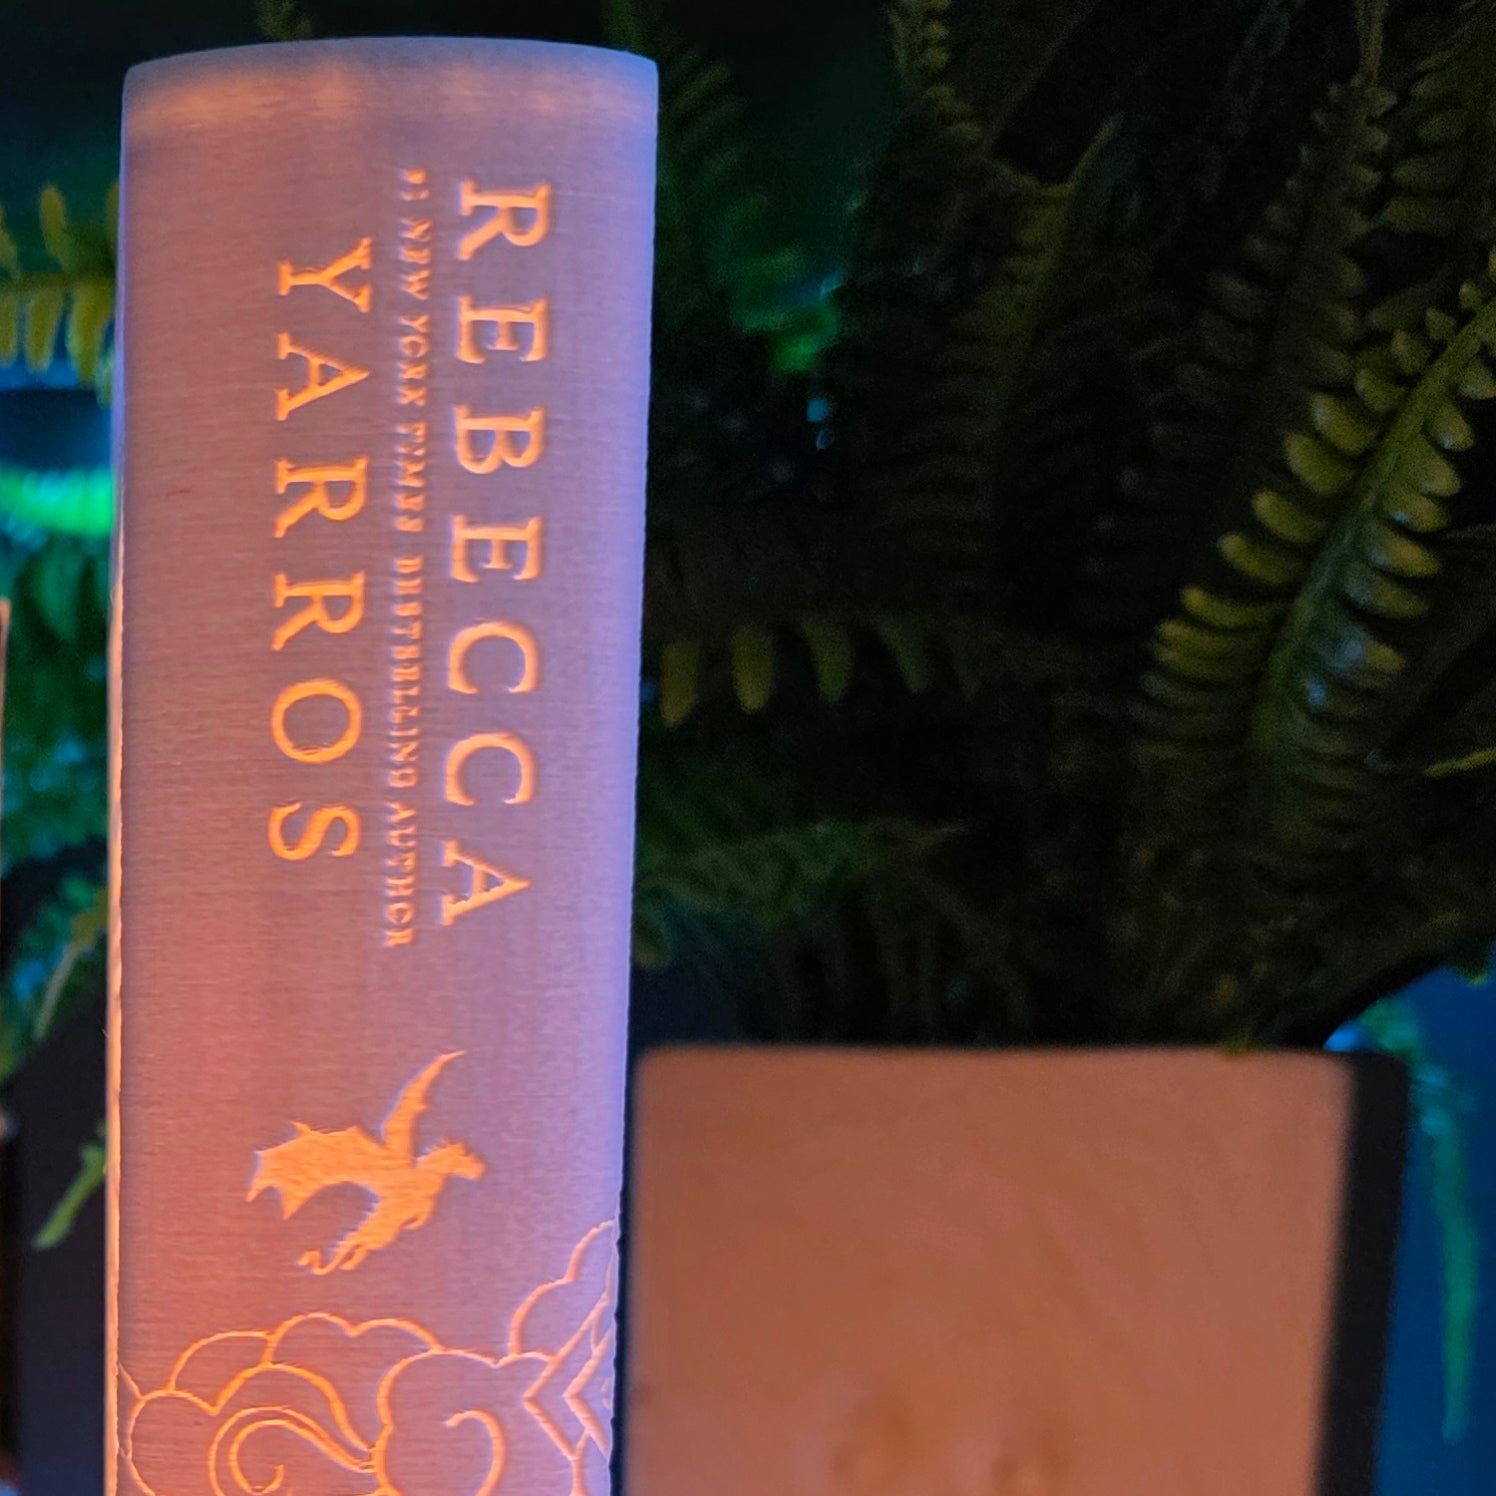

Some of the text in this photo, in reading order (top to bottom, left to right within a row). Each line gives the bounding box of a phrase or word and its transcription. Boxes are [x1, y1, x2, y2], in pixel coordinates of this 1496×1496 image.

[398, 217, 432, 302] NEW
[268, 235, 375, 862] YARROS
[442, 179, 553, 927] REBECCA
[382, 801, 419, 949] AUTHOR
